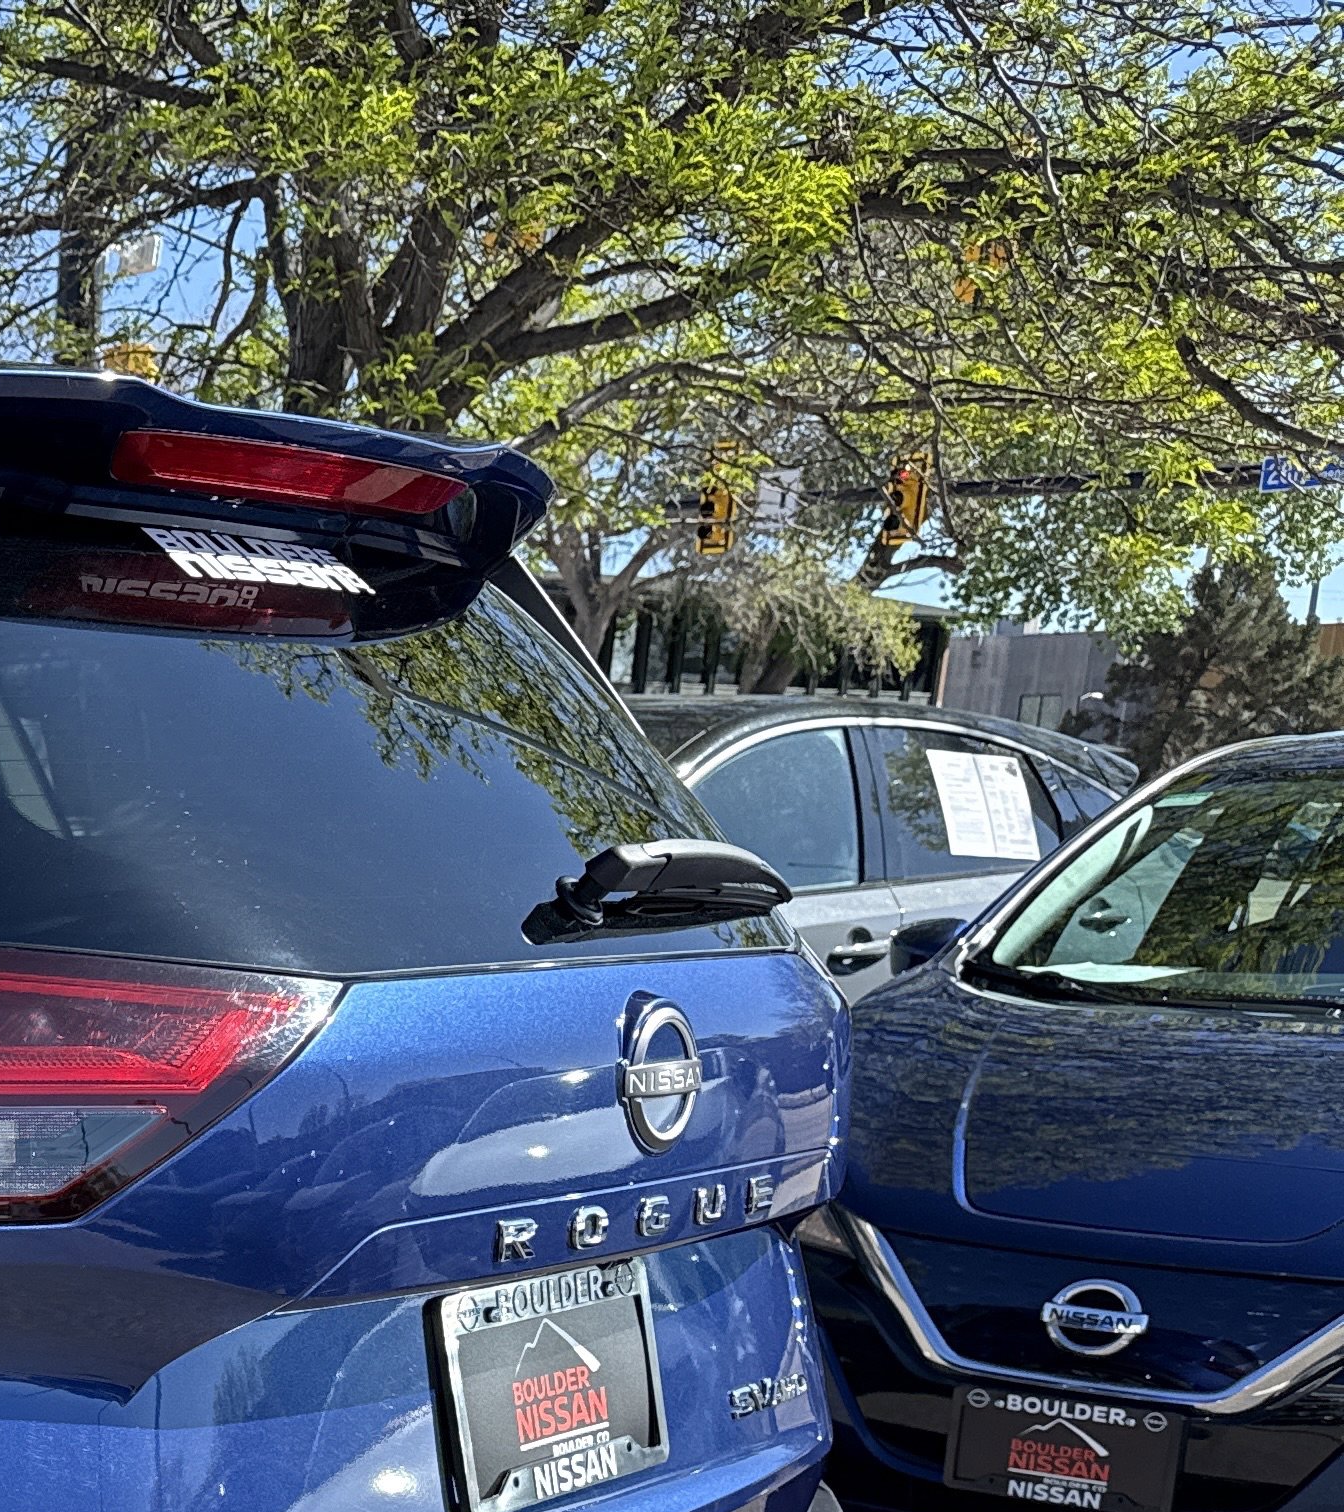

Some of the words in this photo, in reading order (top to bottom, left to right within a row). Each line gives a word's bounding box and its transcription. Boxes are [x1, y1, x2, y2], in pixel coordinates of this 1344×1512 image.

[493, 1174, 774, 1263] ROGUE
[495, 1268, 605, 1322] BOULDER
[1049, 1307, 1132, 1330] NISSAN
[513, 1366, 592, 1405] BOULDER
[514, 1386, 609, 1443] NISSAN
[1006, 1394, 1127, 1426] BOULDER
[1008, 1451, 1110, 1482] NISSAN
[1010, 1437, 1097, 1463] BOULDER
[533, 1444, 618, 1500] NISSAN
[1007, 1479, 1102, 1511] NISSAN
